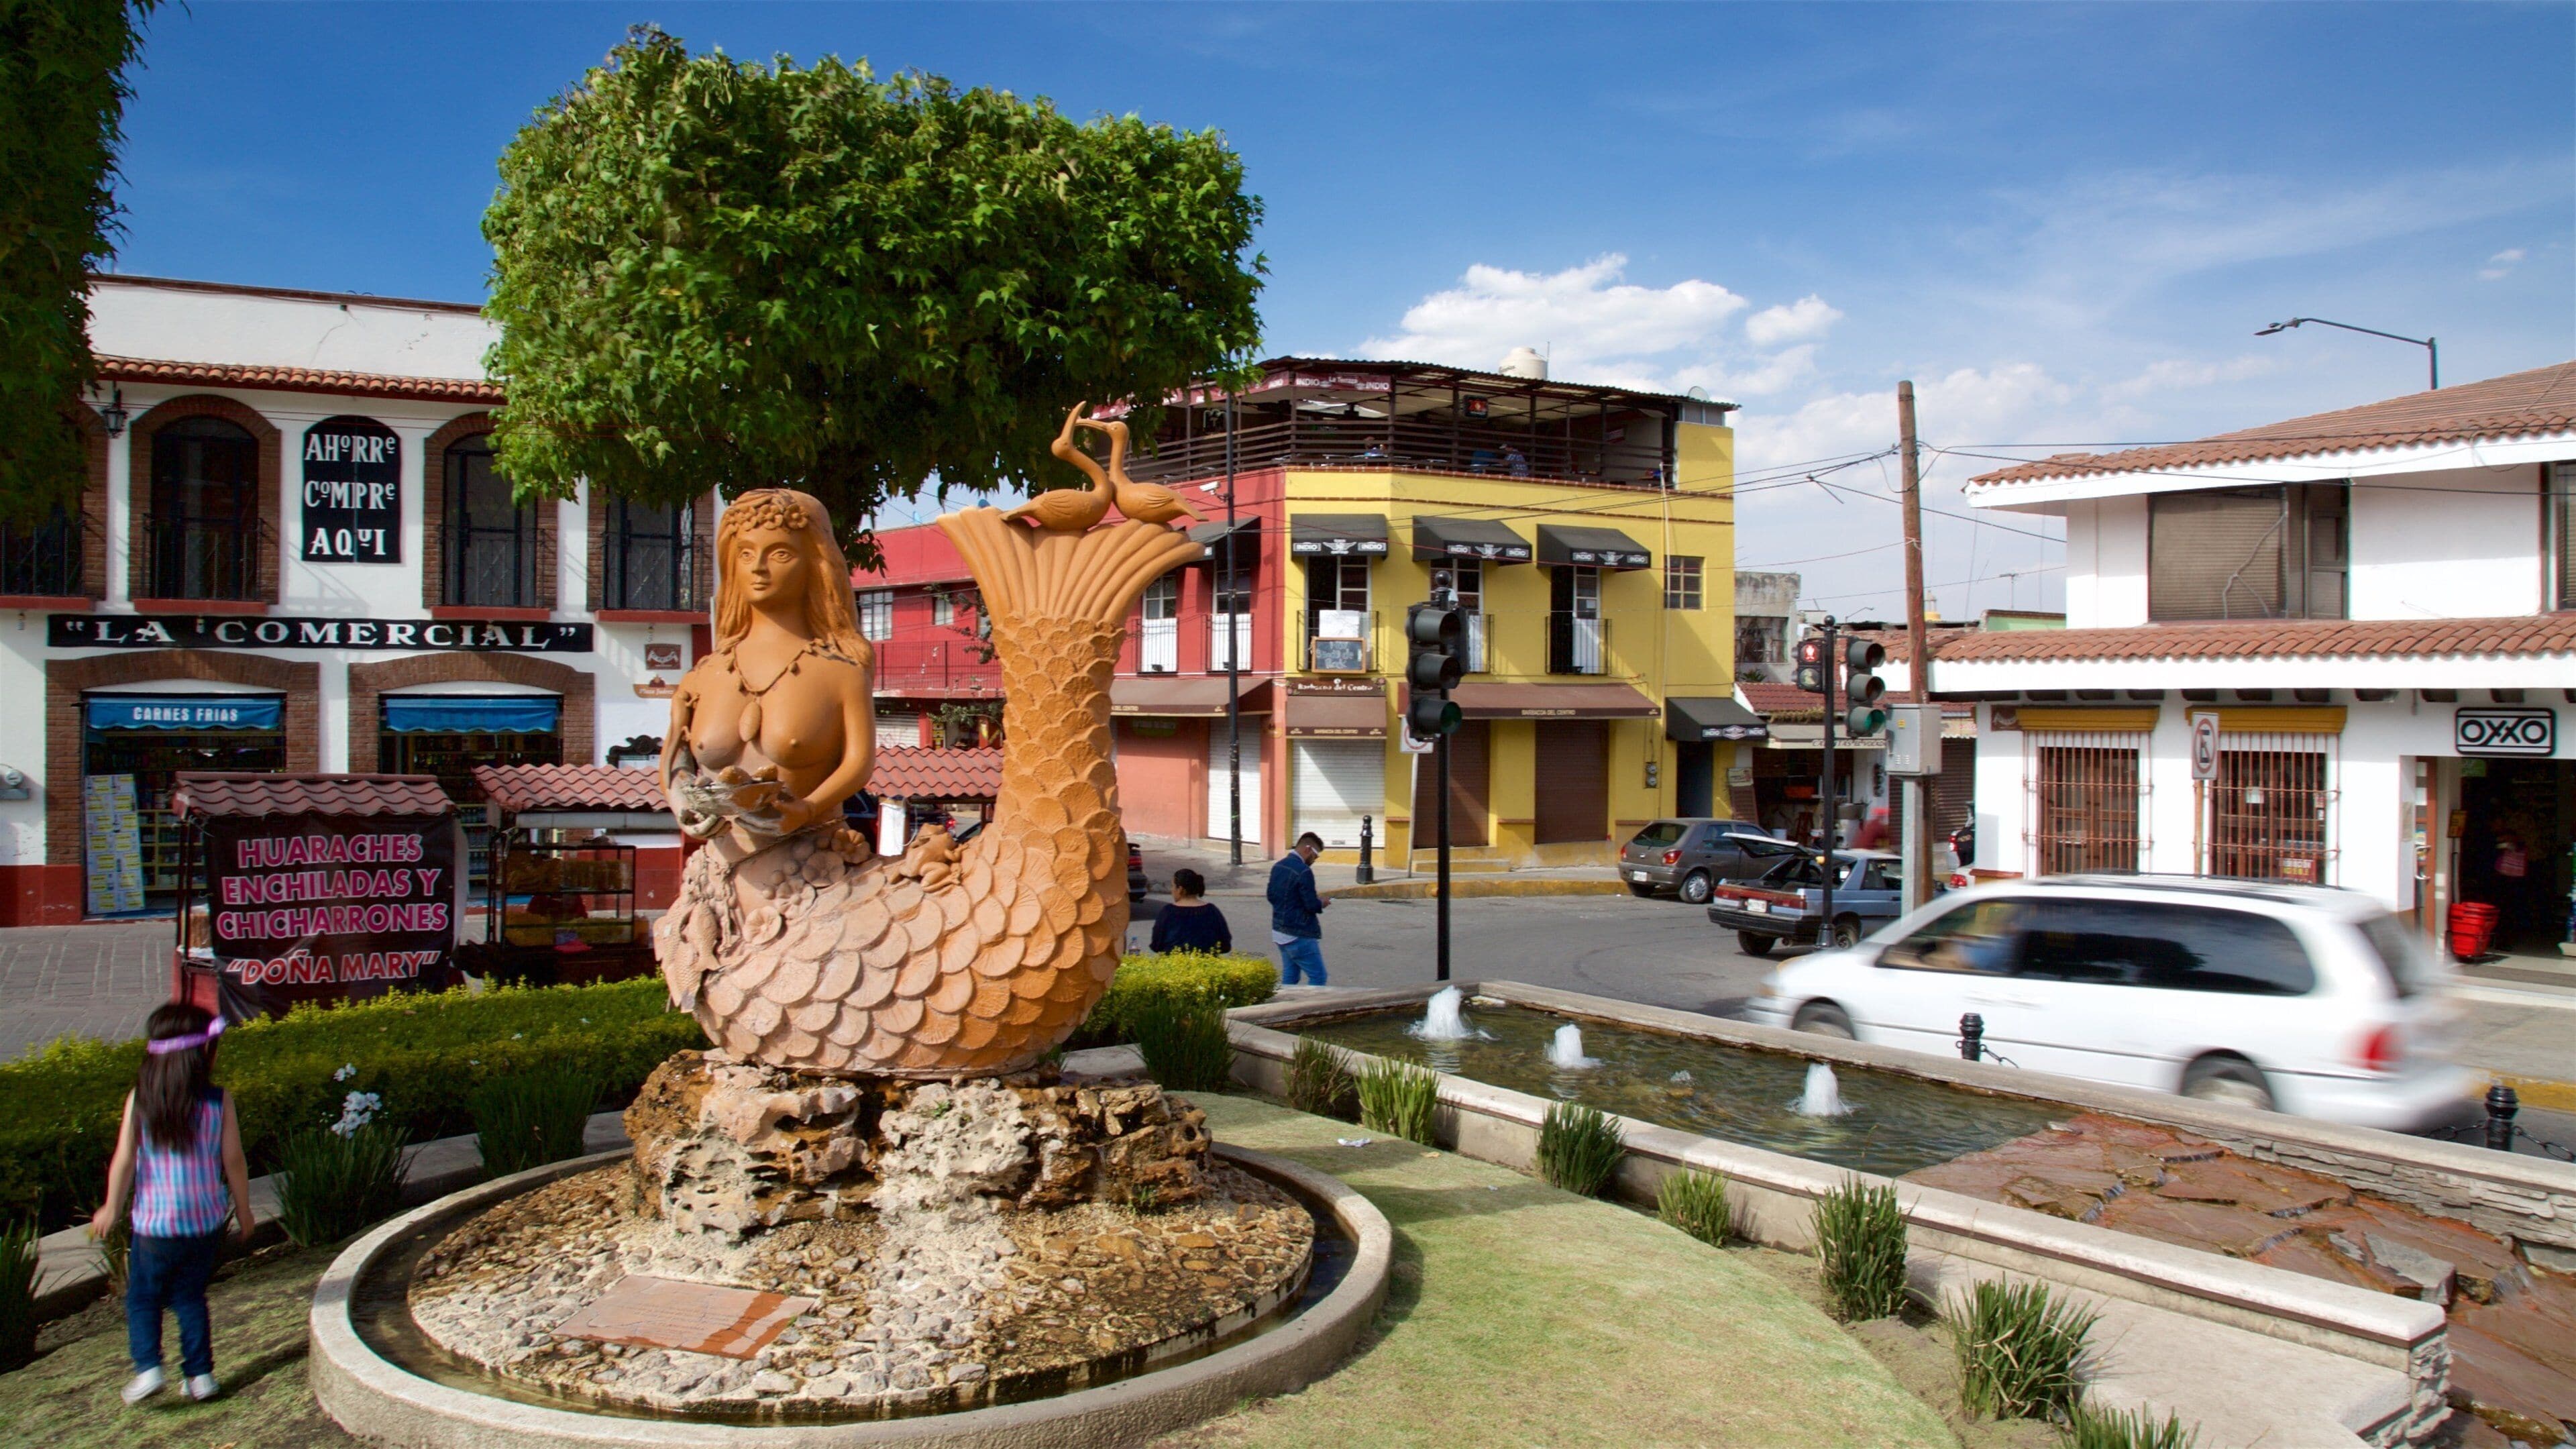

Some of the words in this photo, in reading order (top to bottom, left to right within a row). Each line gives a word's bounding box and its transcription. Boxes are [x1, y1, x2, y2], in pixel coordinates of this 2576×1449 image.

[1296, 378, 1320, 386] INDIO
[1365, 382, 1390, 390] INDIO
[133, 706, 190, 721] CARNES
[196, 708, 238, 722] FRIAS
[2461, 717, 2547, 745] OXXO
[237, 834, 423, 869] HUARACHES
[221, 869, 412, 905] ENCHILADAS
[417, 868, 442, 896] Y
[217, 903, 449, 939] CHICHARRONES
